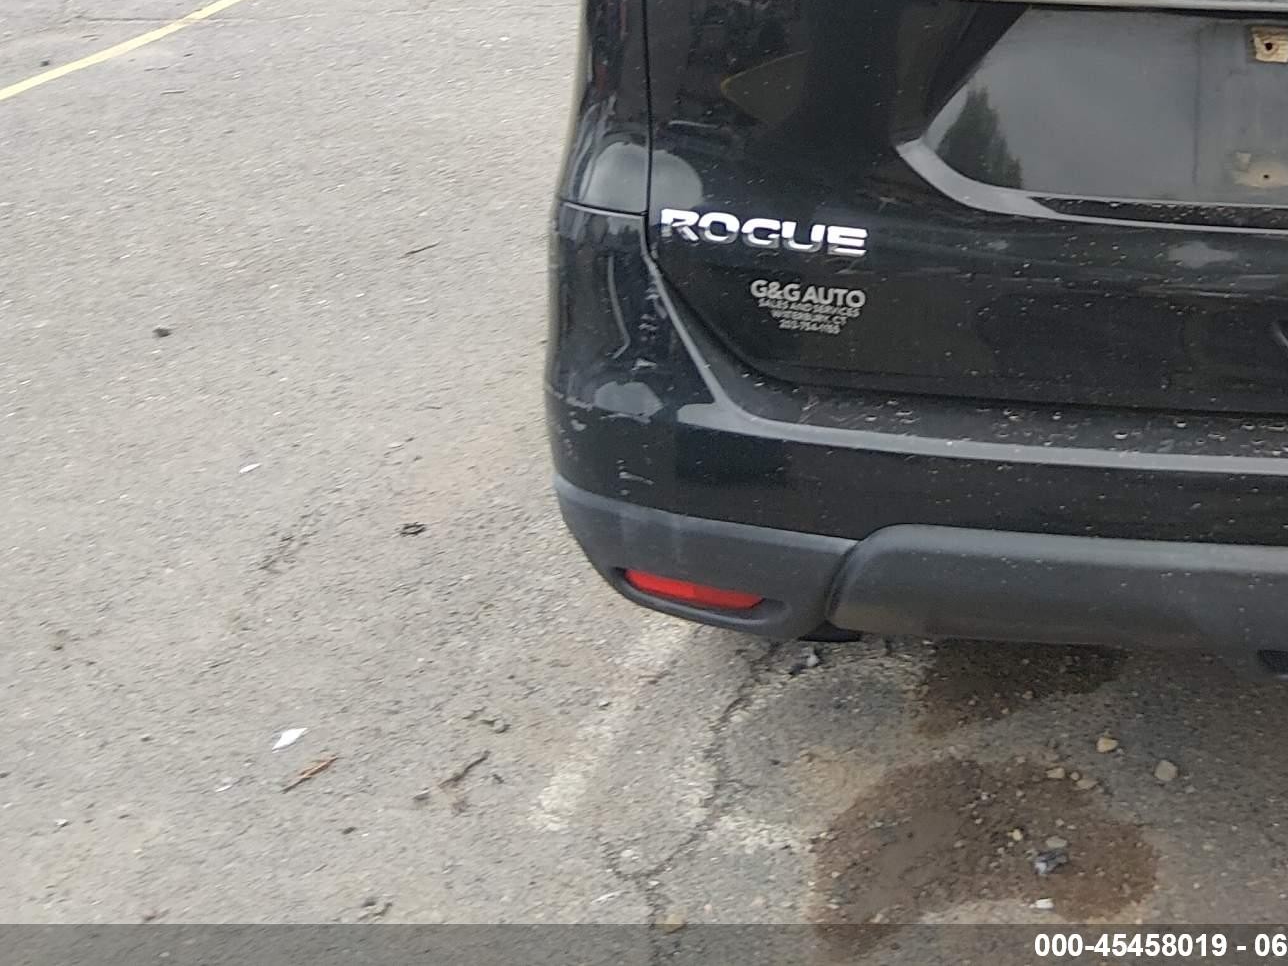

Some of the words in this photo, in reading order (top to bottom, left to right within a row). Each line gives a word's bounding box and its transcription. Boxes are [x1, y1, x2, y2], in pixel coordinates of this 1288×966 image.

[660, 208, 869, 257] ROGUE
[751, 279, 801, 302] G&G
[802, 285, 866, 308] AUTO
